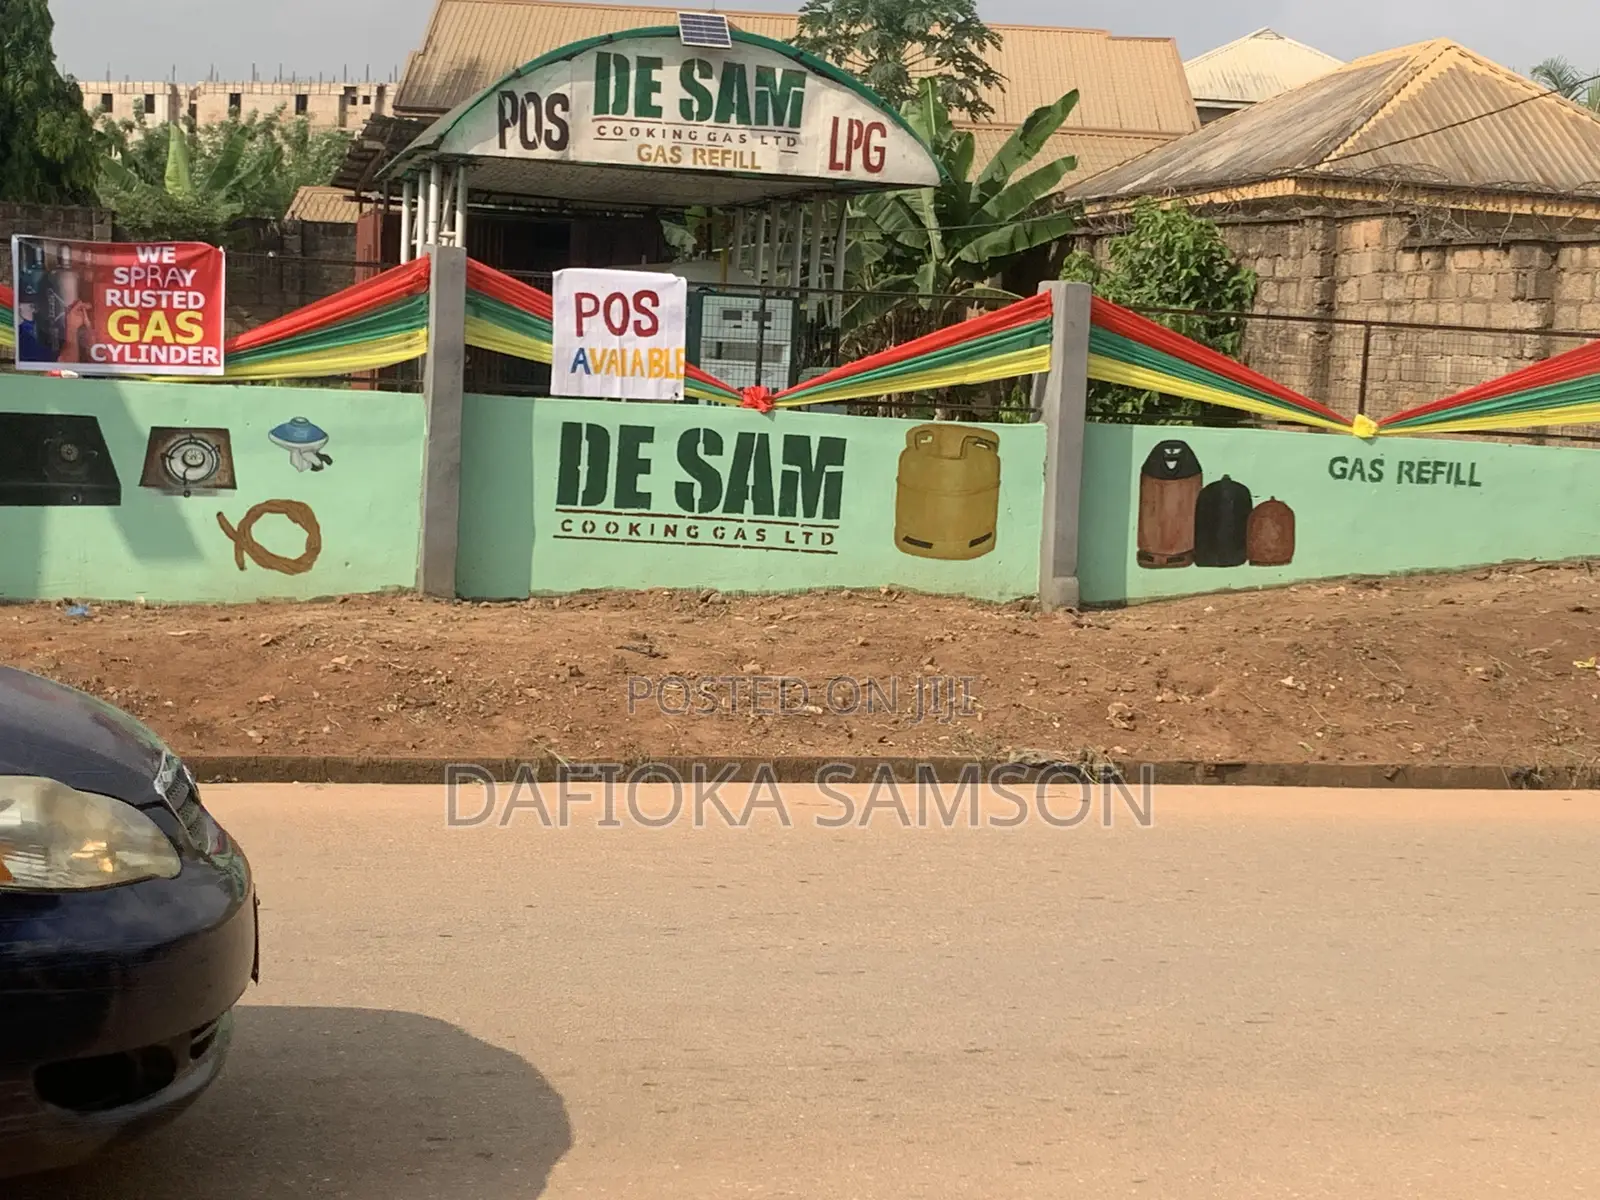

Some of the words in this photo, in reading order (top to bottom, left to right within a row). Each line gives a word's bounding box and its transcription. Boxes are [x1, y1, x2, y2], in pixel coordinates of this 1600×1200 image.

[593, 52, 664, 118] DE
[679, 57, 807, 129] SAM
[498, 90, 570, 151] POS
[597, 125, 697, 141] COOKING
[707, 131, 747, 144] GAS
[760, 136, 798, 147] LTD
[829, 116, 887, 174] LPG
[637, 143, 682, 164] GAS
[692, 147, 762, 170] REFILL
[136, 246, 176, 264] WE
[113, 265, 197, 288] SPRAY
[105, 289, 205, 309] RUSTED
[107, 309, 204, 344] GAS
[574, 290, 660, 338] POS
[90, 344, 220, 365] CYLINDER
[555, 421, 655, 510] DE
[674, 427, 847, 520] SAM
[1328, 456, 1385, 483] GAS
[1397, 460, 1482, 487] REFILL
[560, 519, 699, 539] COOKING
[712, 526, 767, 541] GAS
[784, 530, 834, 546] LTD
